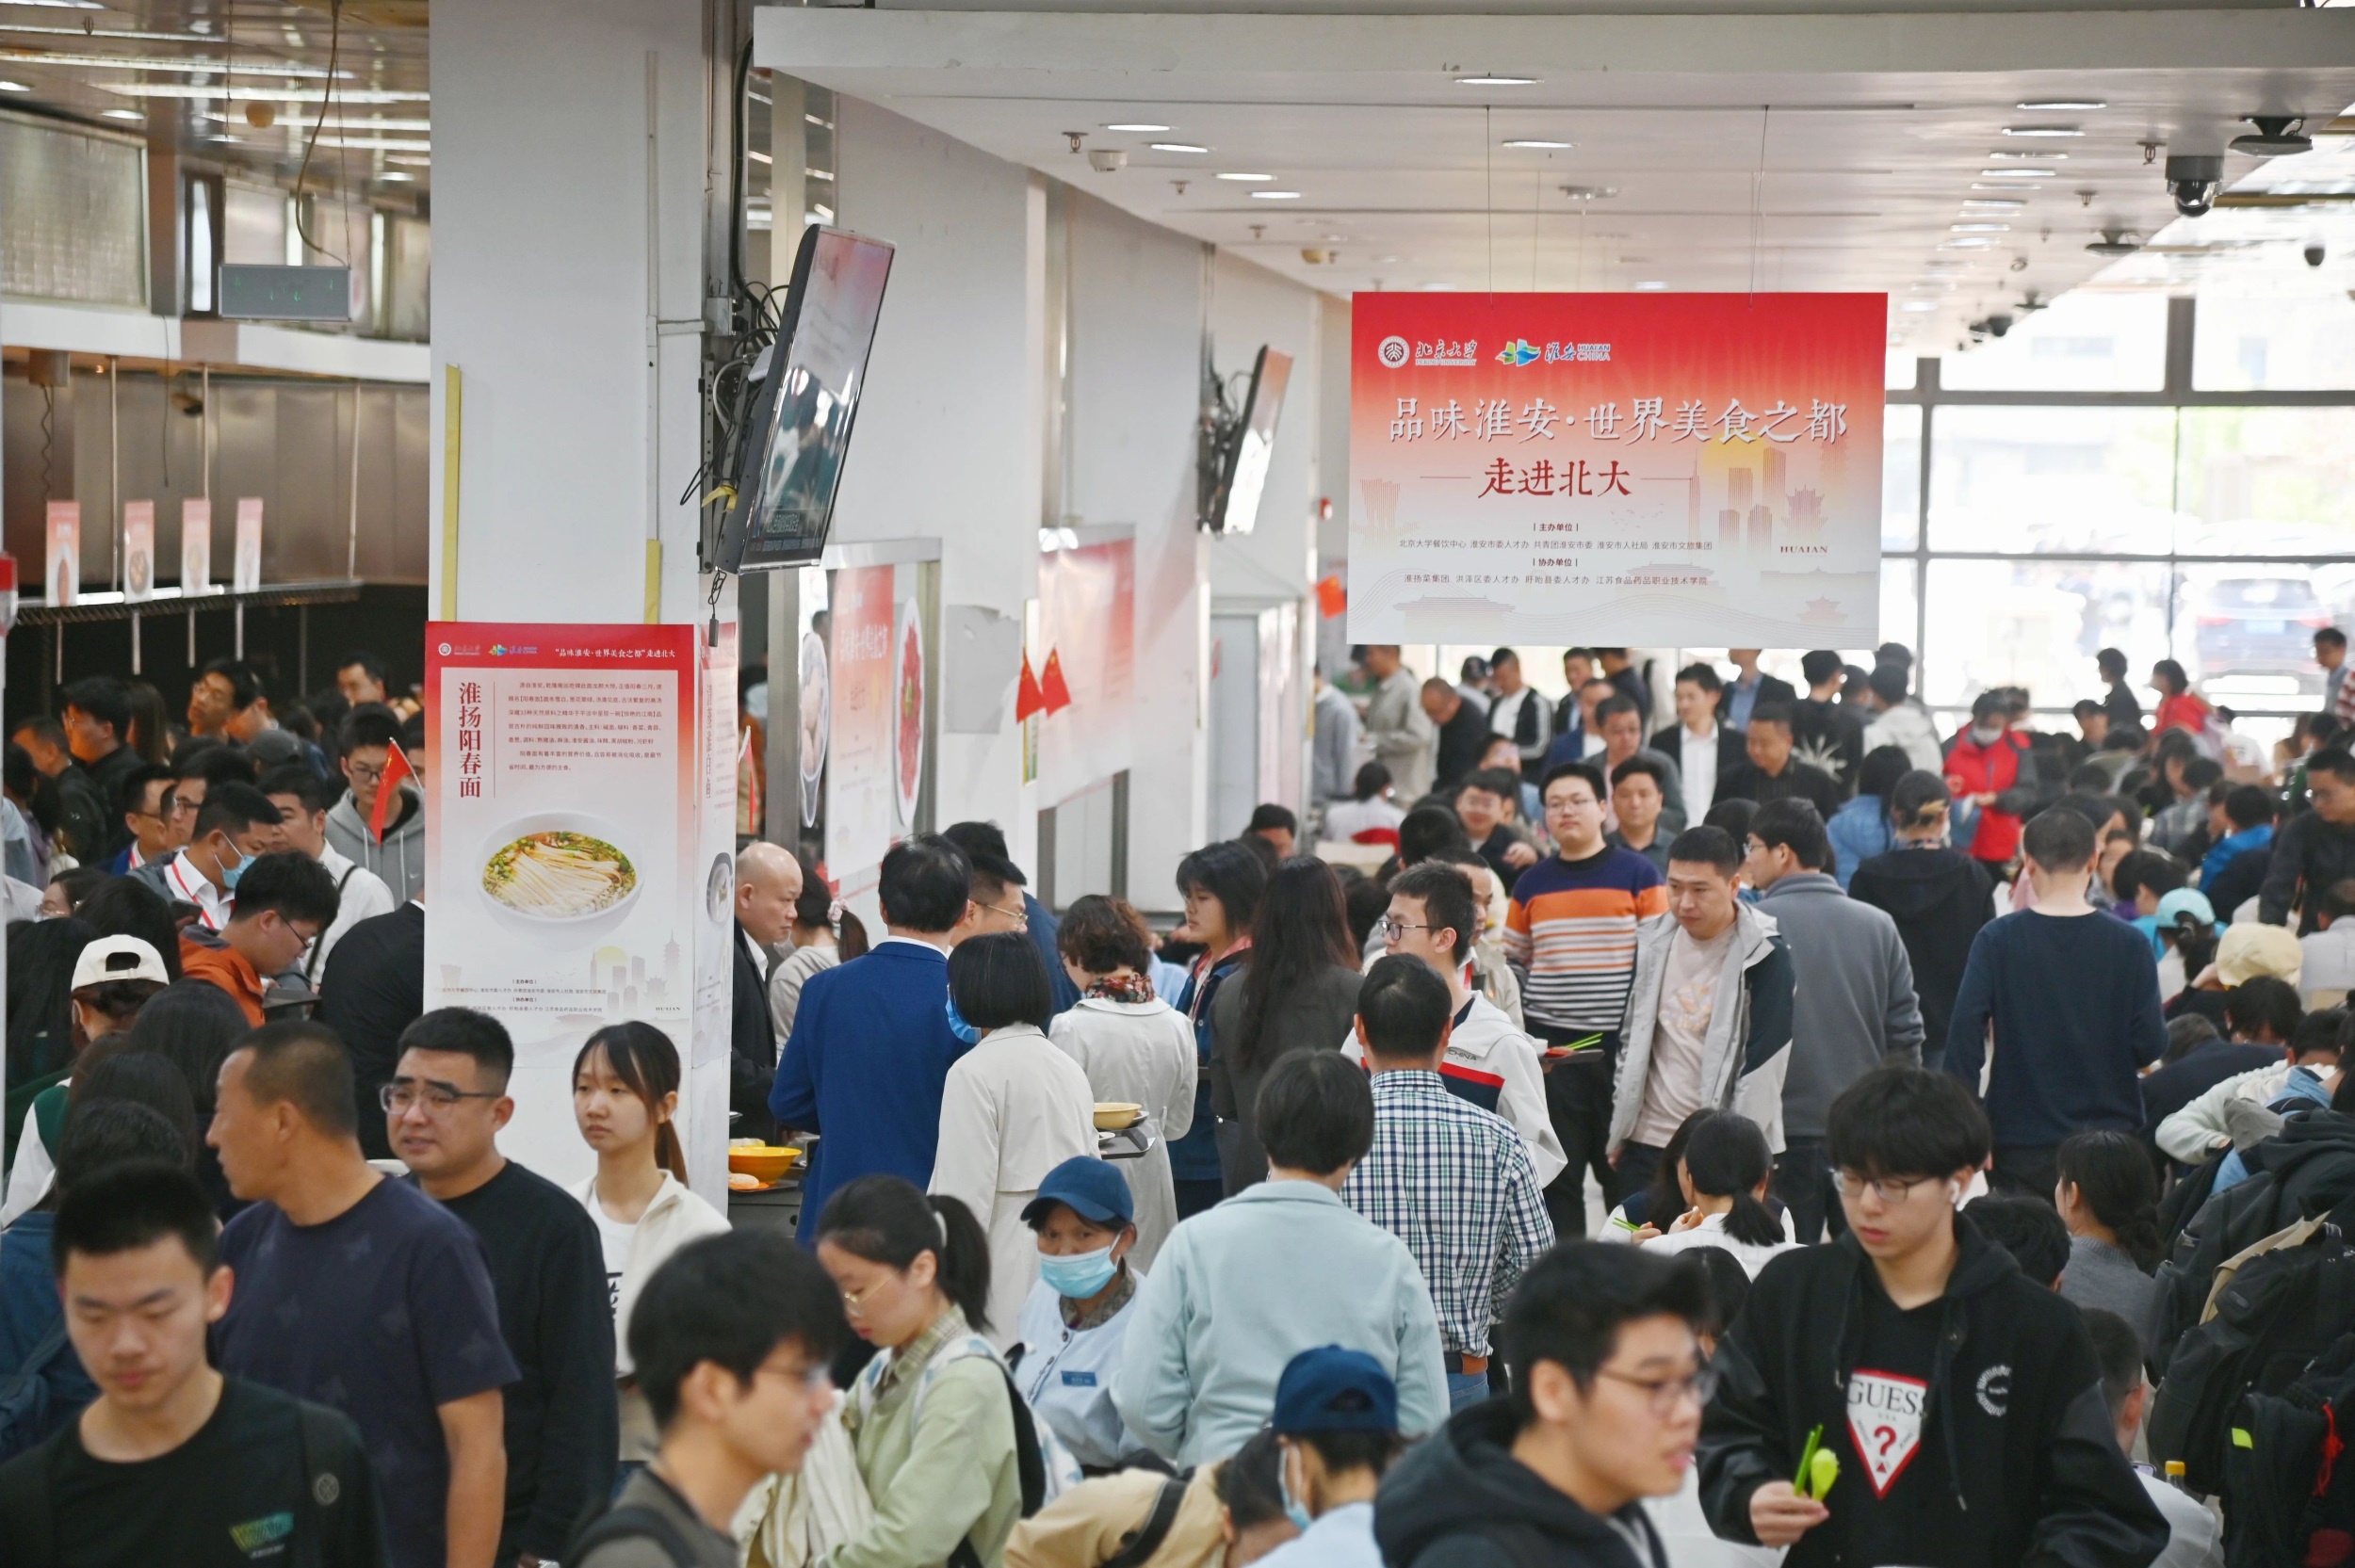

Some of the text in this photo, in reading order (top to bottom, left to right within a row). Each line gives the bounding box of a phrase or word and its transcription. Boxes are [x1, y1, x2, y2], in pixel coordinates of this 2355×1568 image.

[1415, 339, 1477, 359] 北京大学
[1545, 342, 1576, 364] 淮安
[1577, 352, 1610, 361] CHINA
[1389, 396, 1849, 445] 品味淮安·世界美食之都
[1478, 457, 1632, 499] 走进北大
[1399, 539, 1713, 550] 北京大学餐饮中心 淮安市委人才办 共青团淮安市委 淮安市人社局 淮安市文旅集团
[1780, 545, 1828, 554] HUAIAN
[1404, 574, 1450, 584] 淮扬菜集团
[1455, 574, 1519, 584] 洪泽区委人才办
[1596, 575, 1708, 586] 江苏食品药品职业技术学院
[458, 681, 482, 799] 淮扬阳春面
[1448, 1049, 1477, 1060] CHINA
